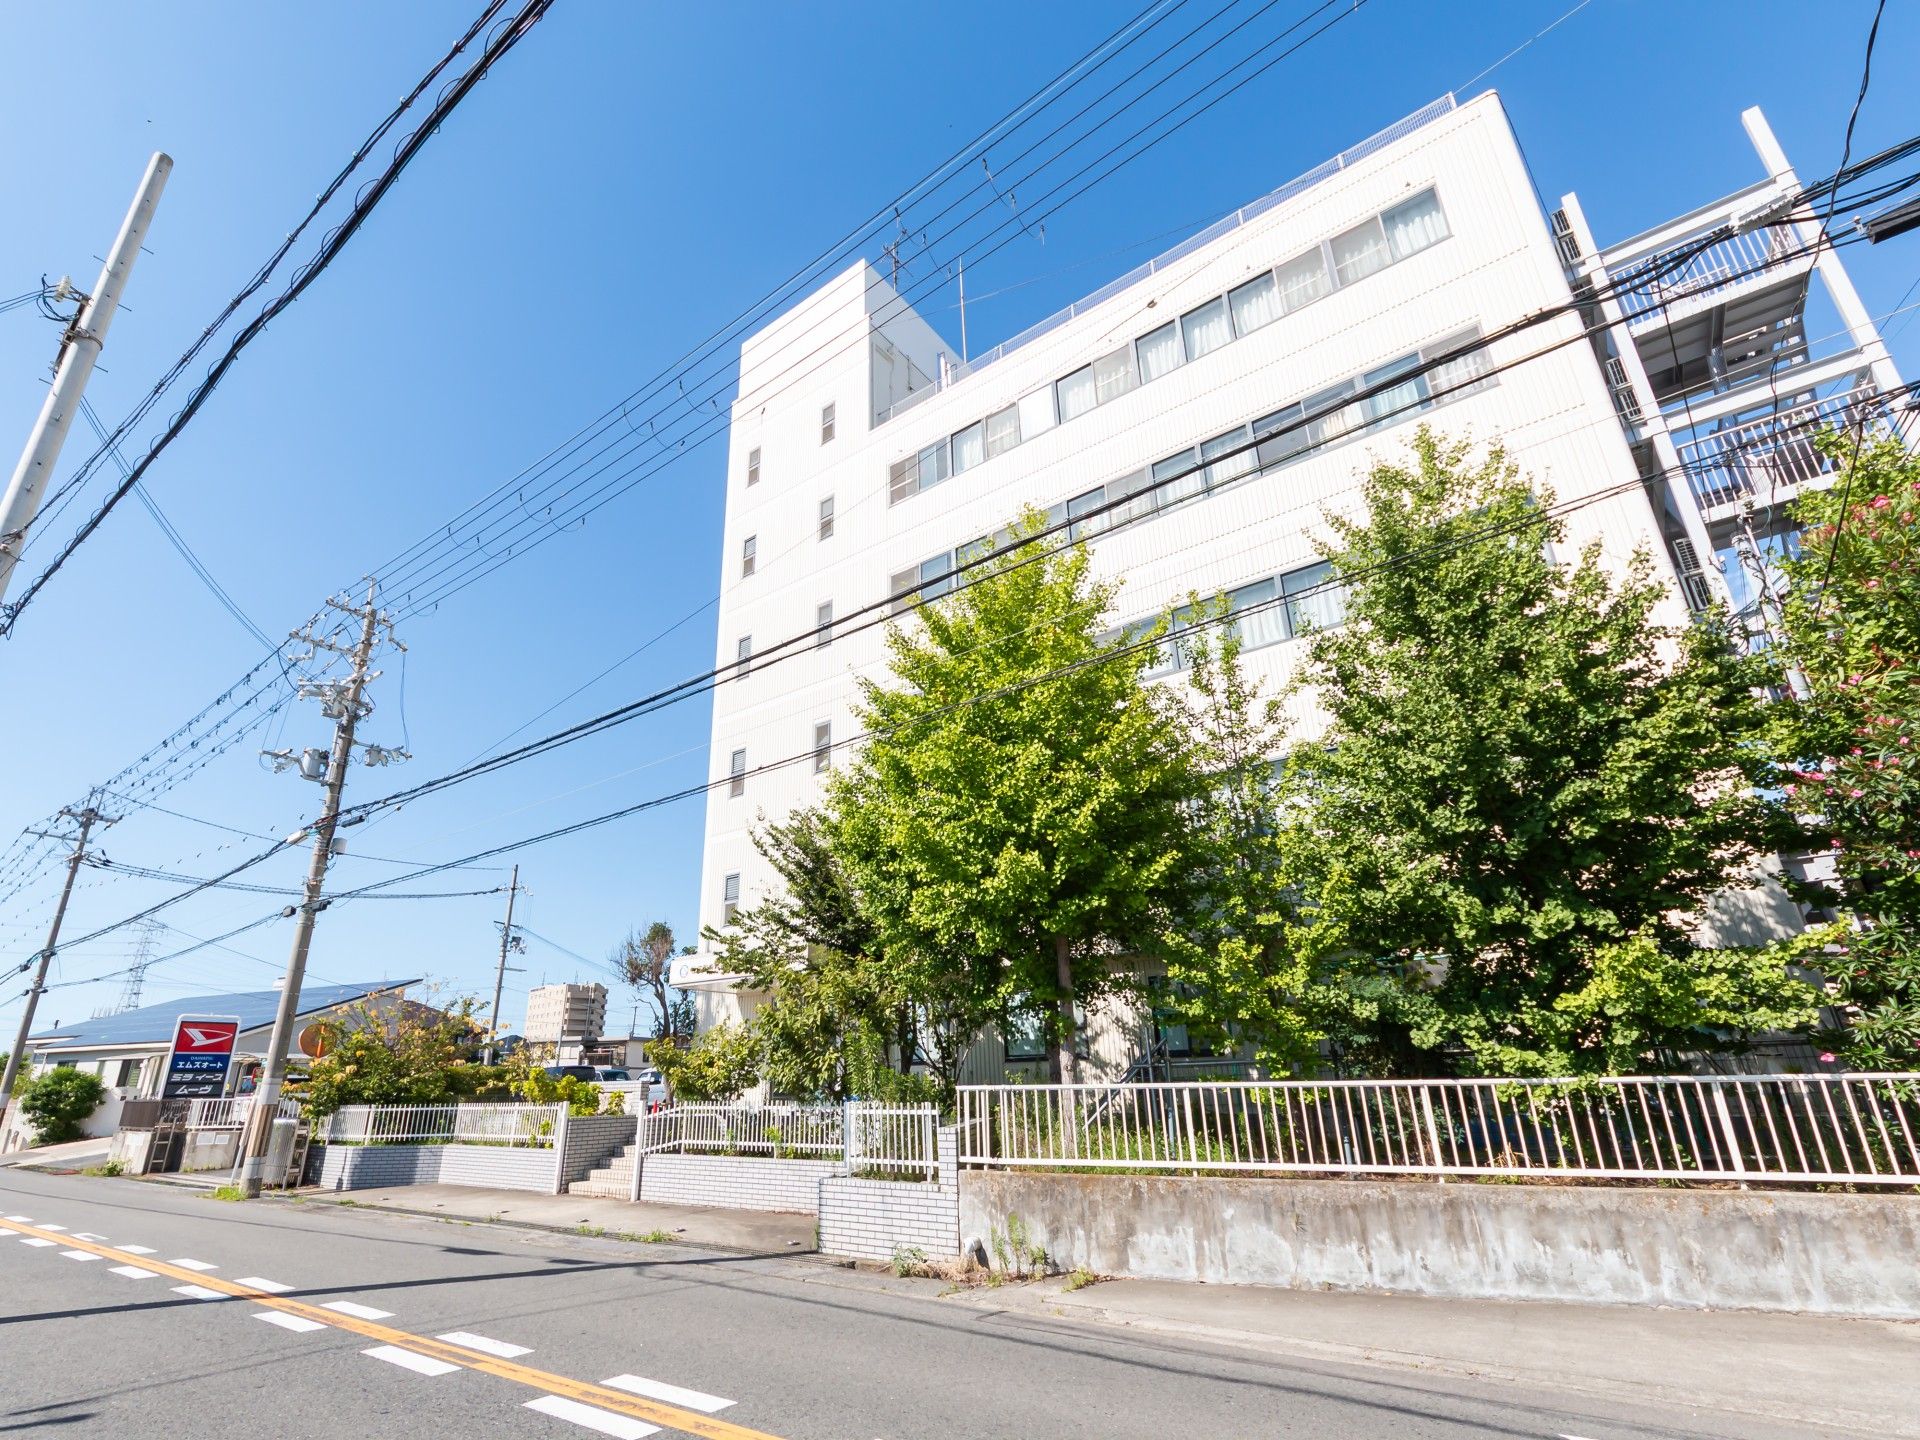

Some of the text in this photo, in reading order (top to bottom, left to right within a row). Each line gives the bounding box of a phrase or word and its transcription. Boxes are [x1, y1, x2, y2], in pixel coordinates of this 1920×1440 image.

[176, 1061, 223, 1069] エムズオート
[175, 1085, 213, 1094] ムーヴ
